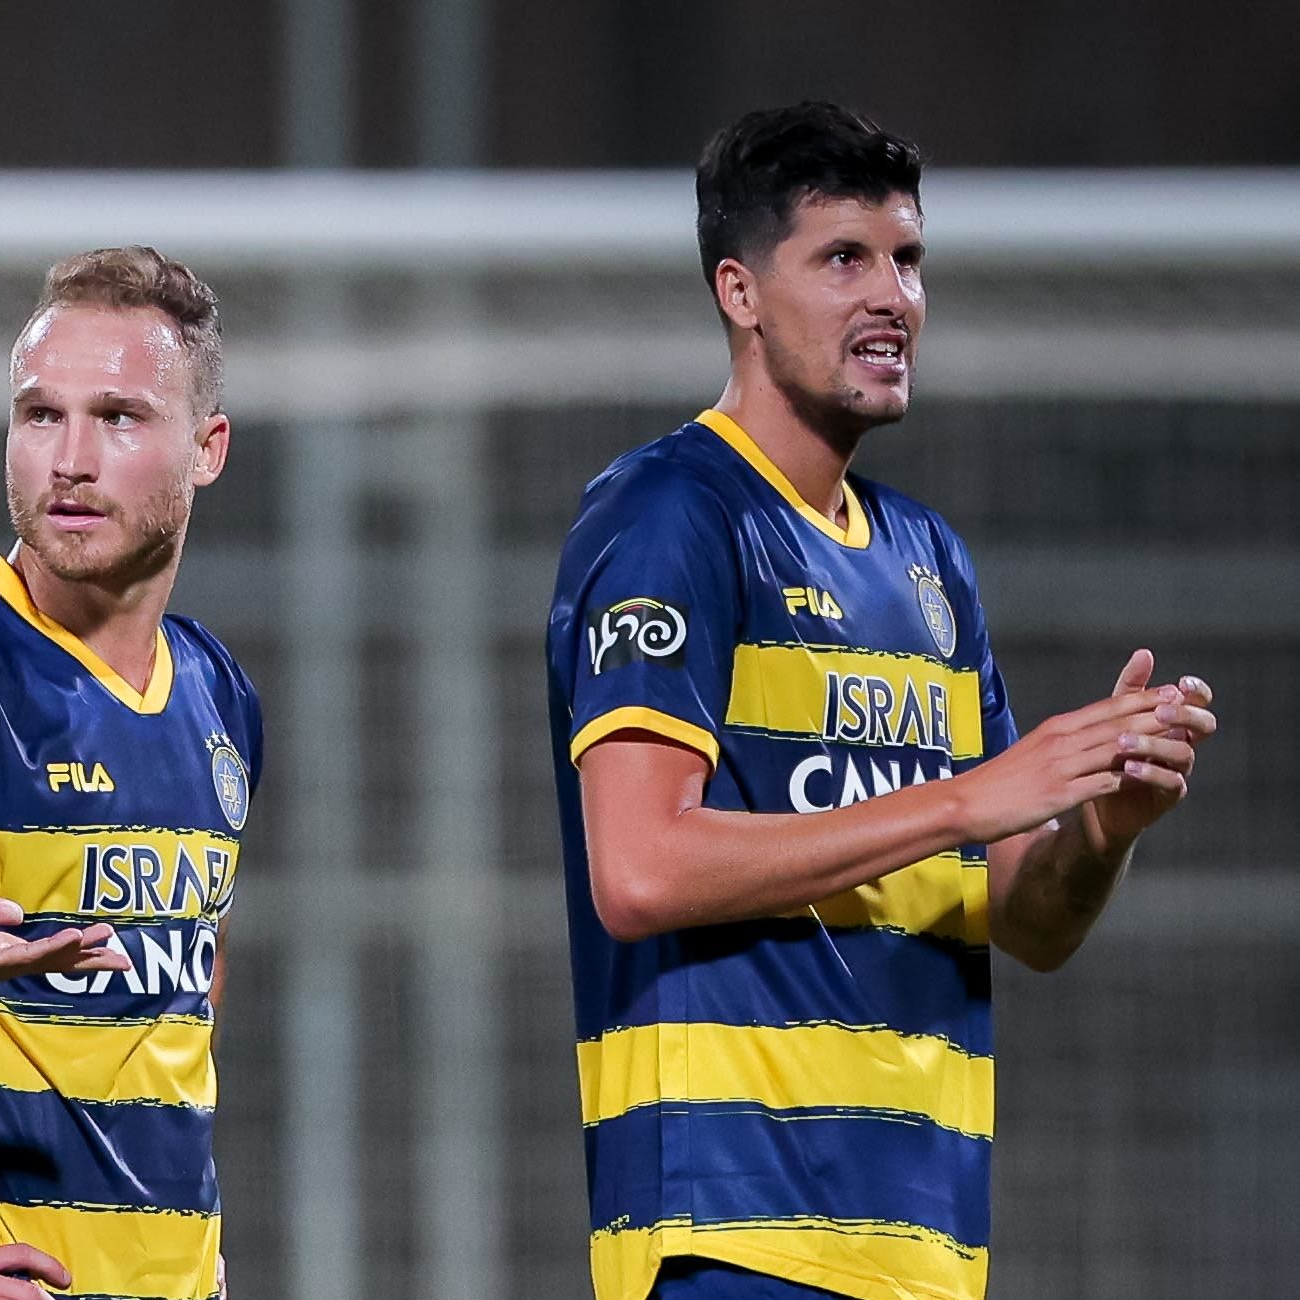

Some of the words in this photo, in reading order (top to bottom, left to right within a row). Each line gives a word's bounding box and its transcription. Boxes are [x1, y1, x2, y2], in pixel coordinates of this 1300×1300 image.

[782, 586, 844, 620] FILA
[822, 672, 953, 756] ISRAEL
[46, 762, 116, 793] FILA
